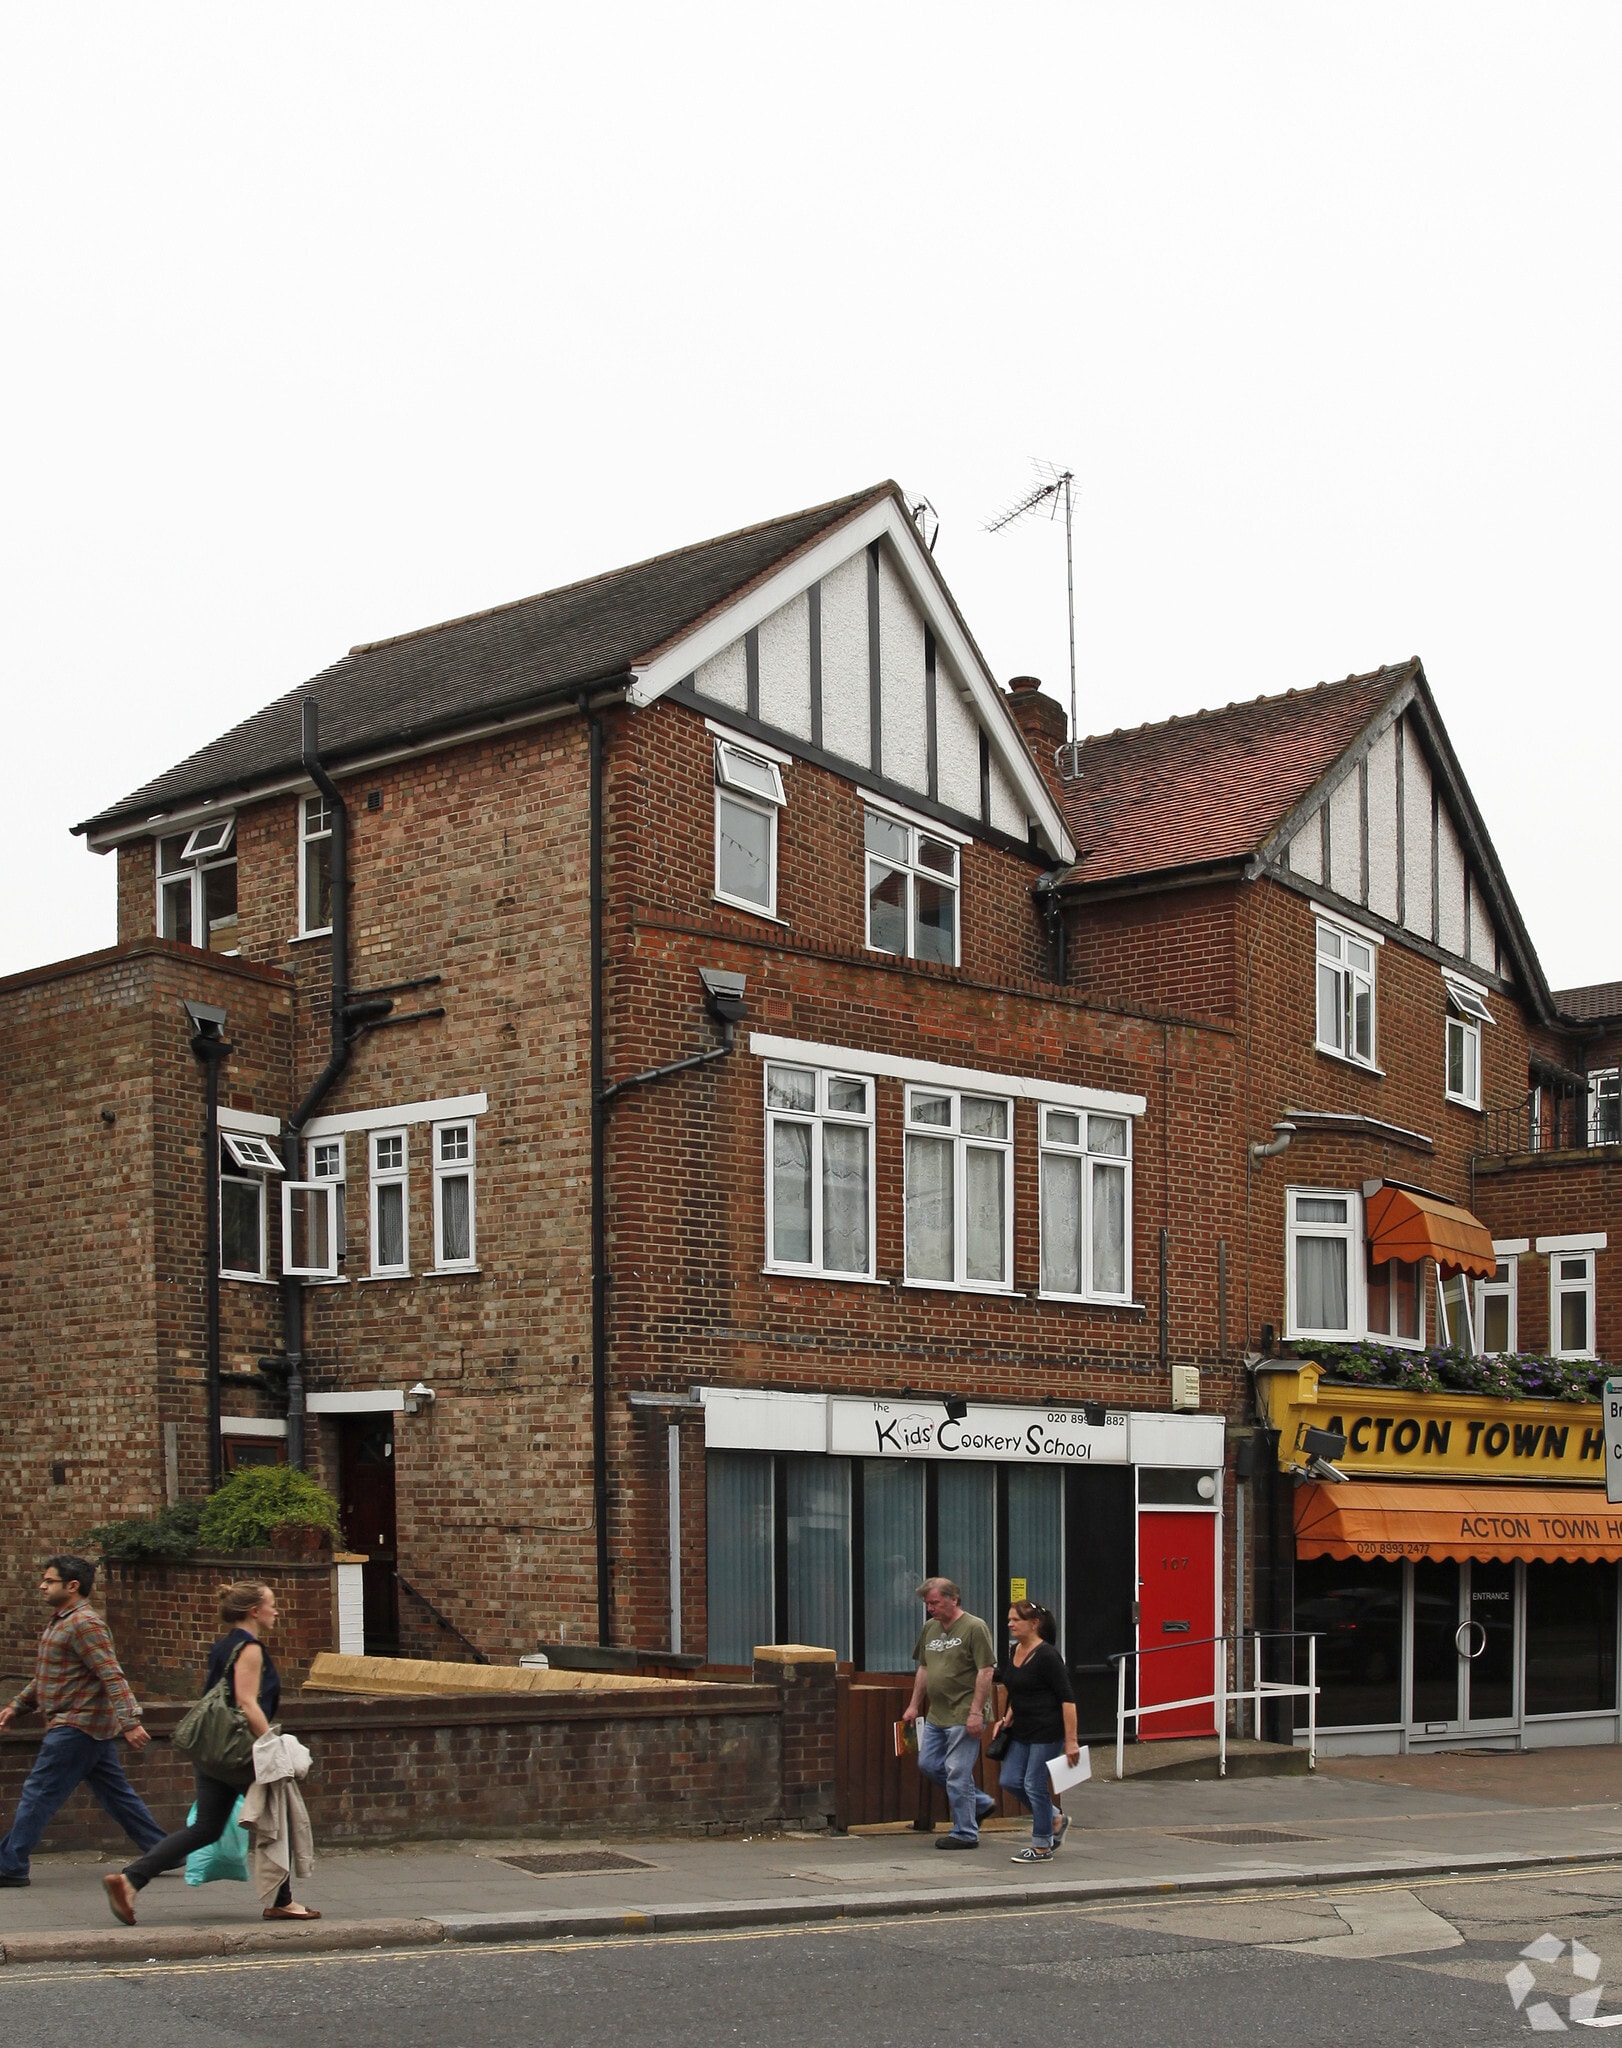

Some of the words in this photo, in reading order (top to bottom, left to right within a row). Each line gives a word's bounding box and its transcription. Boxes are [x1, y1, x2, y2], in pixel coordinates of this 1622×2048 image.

[873, 1402, 890, 1413] the
[1047, 1413, 1067, 1423] 020
[1071, 1414, 1088, 1424] 899
[1106, 1416, 1125, 1426] 882
[875, 1419, 933, 1453] Kids'
[937, 1419, 1021, 1452] Cookery
[1025, 1424, 1092, 1460] School
[1327, 1416, 1451, 1454] ACTON
[1468, 1421, 1570, 1459] TOWN
[1460, 1517, 1531, 1538] ACTON
[1538, 1518, 1600, 1539] TOWN
[1606, 1520, 1622, 1539] H
[1357, 1543, 1376, 1554] 020
[1380, 1543, 1404, 1554] 8993
[1407, 1544, 1431, 1554] 2477
[1162, 1557, 1189, 1571] 107
[1472, 1591, 1510, 1601] ENTRANCE
